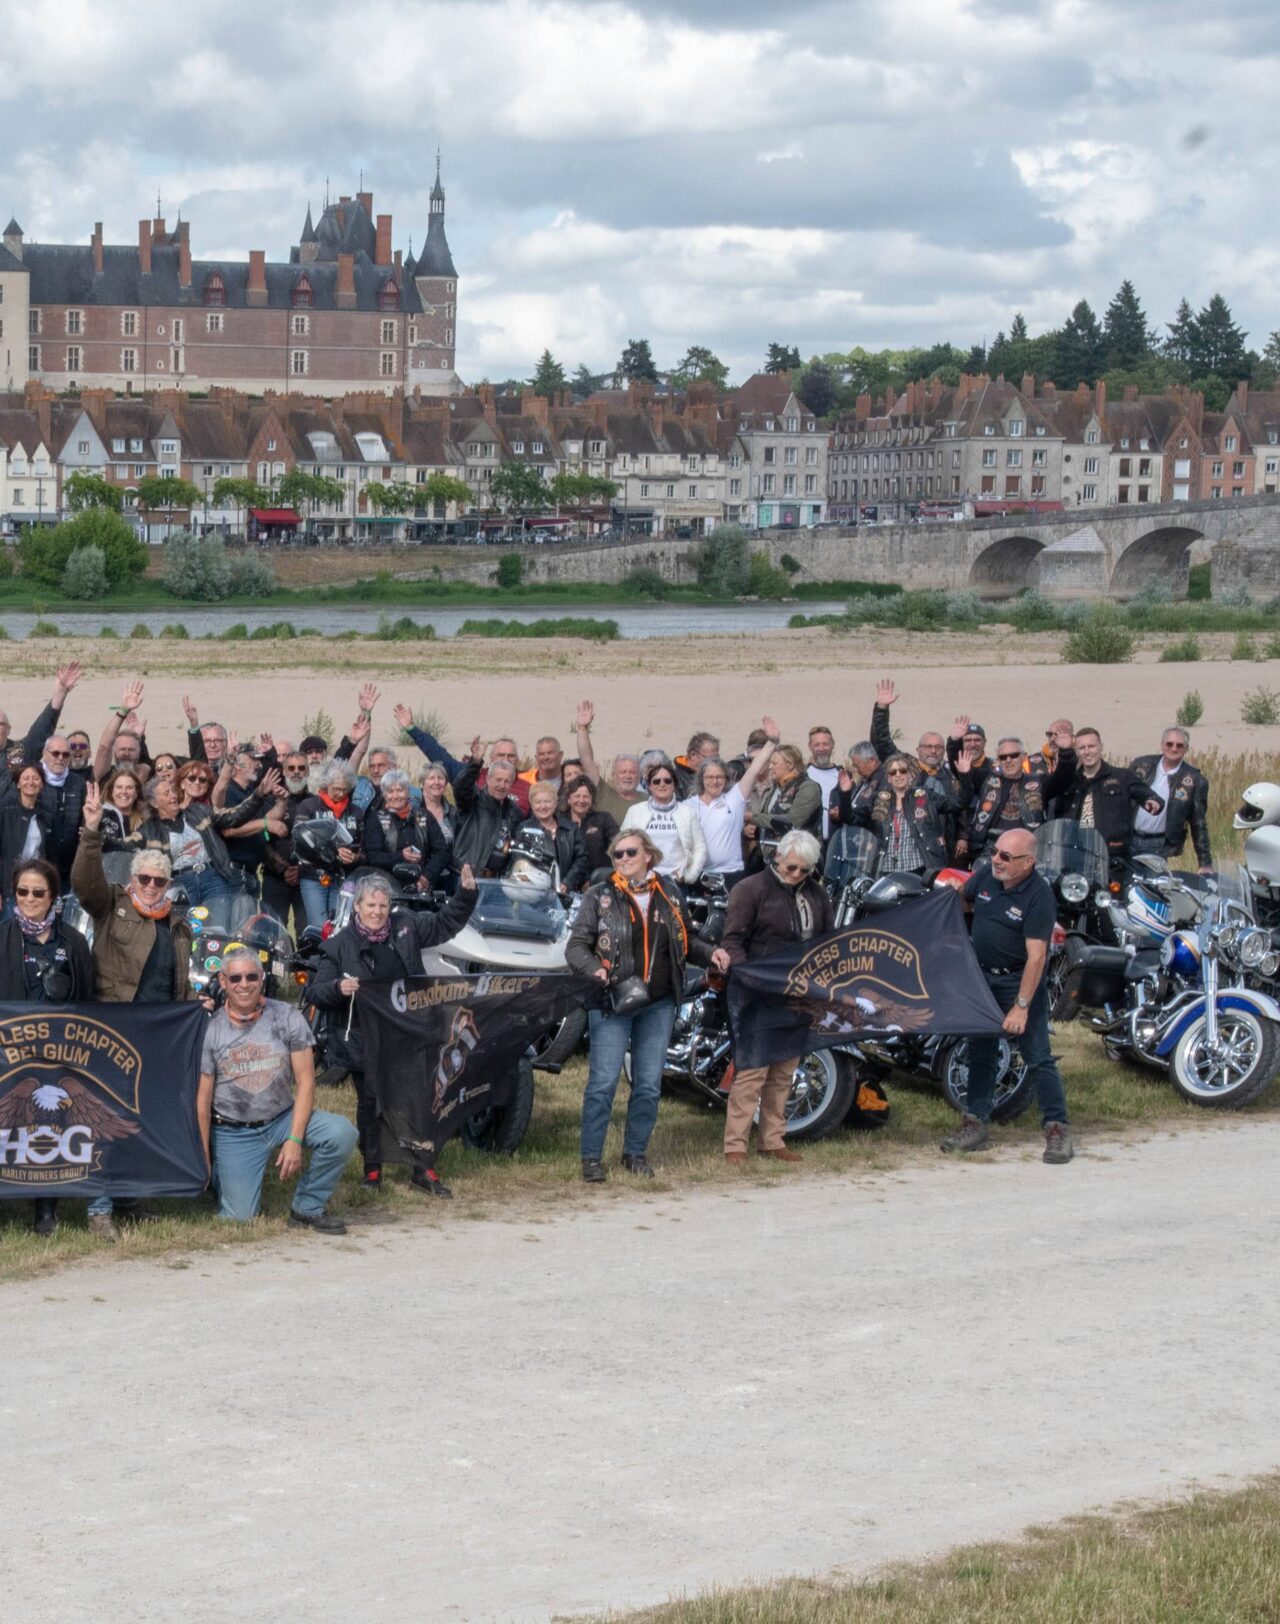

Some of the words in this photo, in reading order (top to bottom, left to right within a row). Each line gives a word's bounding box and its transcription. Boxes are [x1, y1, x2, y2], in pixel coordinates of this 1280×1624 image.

[849, 937, 913, 968] CHAPTER
[814, 956, 874, 989] BELGIUM
[5, 1043, 91, 1067] BELGIUM
[64, 1022, 136, 1075] CHAPTER
[1, 1167, 27, 1179] HARLEY
[28, 1169, 58, 1180] OWNERS
[59, 1166, 84, 1179] GROUP
